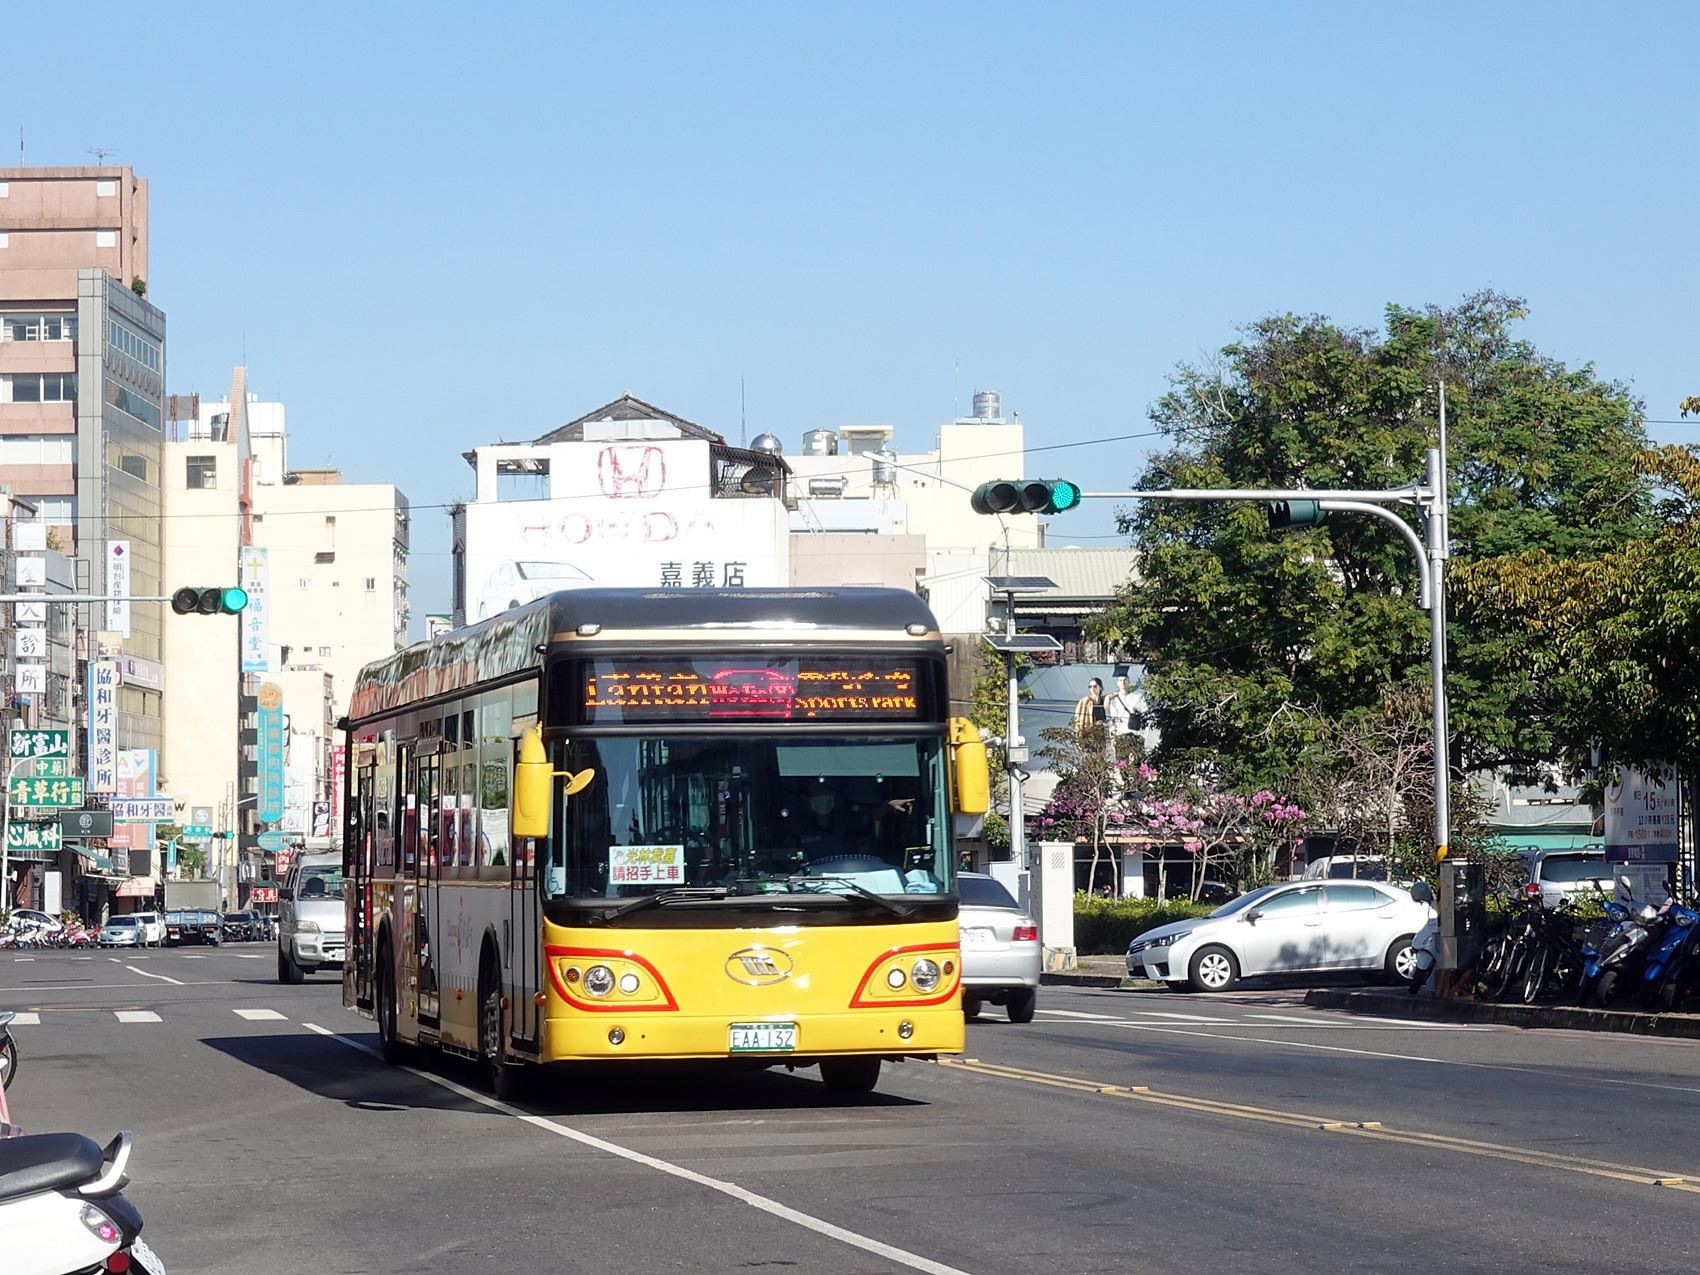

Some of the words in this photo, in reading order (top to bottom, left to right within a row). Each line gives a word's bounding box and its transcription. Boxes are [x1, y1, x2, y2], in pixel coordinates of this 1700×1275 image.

[660, 561, 748, 588] 嘉義店
[248, 598, 263, 650] 福音堂
[96, 668, 112, 787] 協和牙醫診所
[12, 732, 68, 757] 新富山
[36, 760, 63, 776] 中藥
[12, 780, 71, 805] 青草行
[1643, 792, 1656, 811] 15
[113, 802, 166, 817] 協和牙醫
[612, 865, 680, 881] 請招手上車
[732, 1030, 794, 1048] EAA-132
